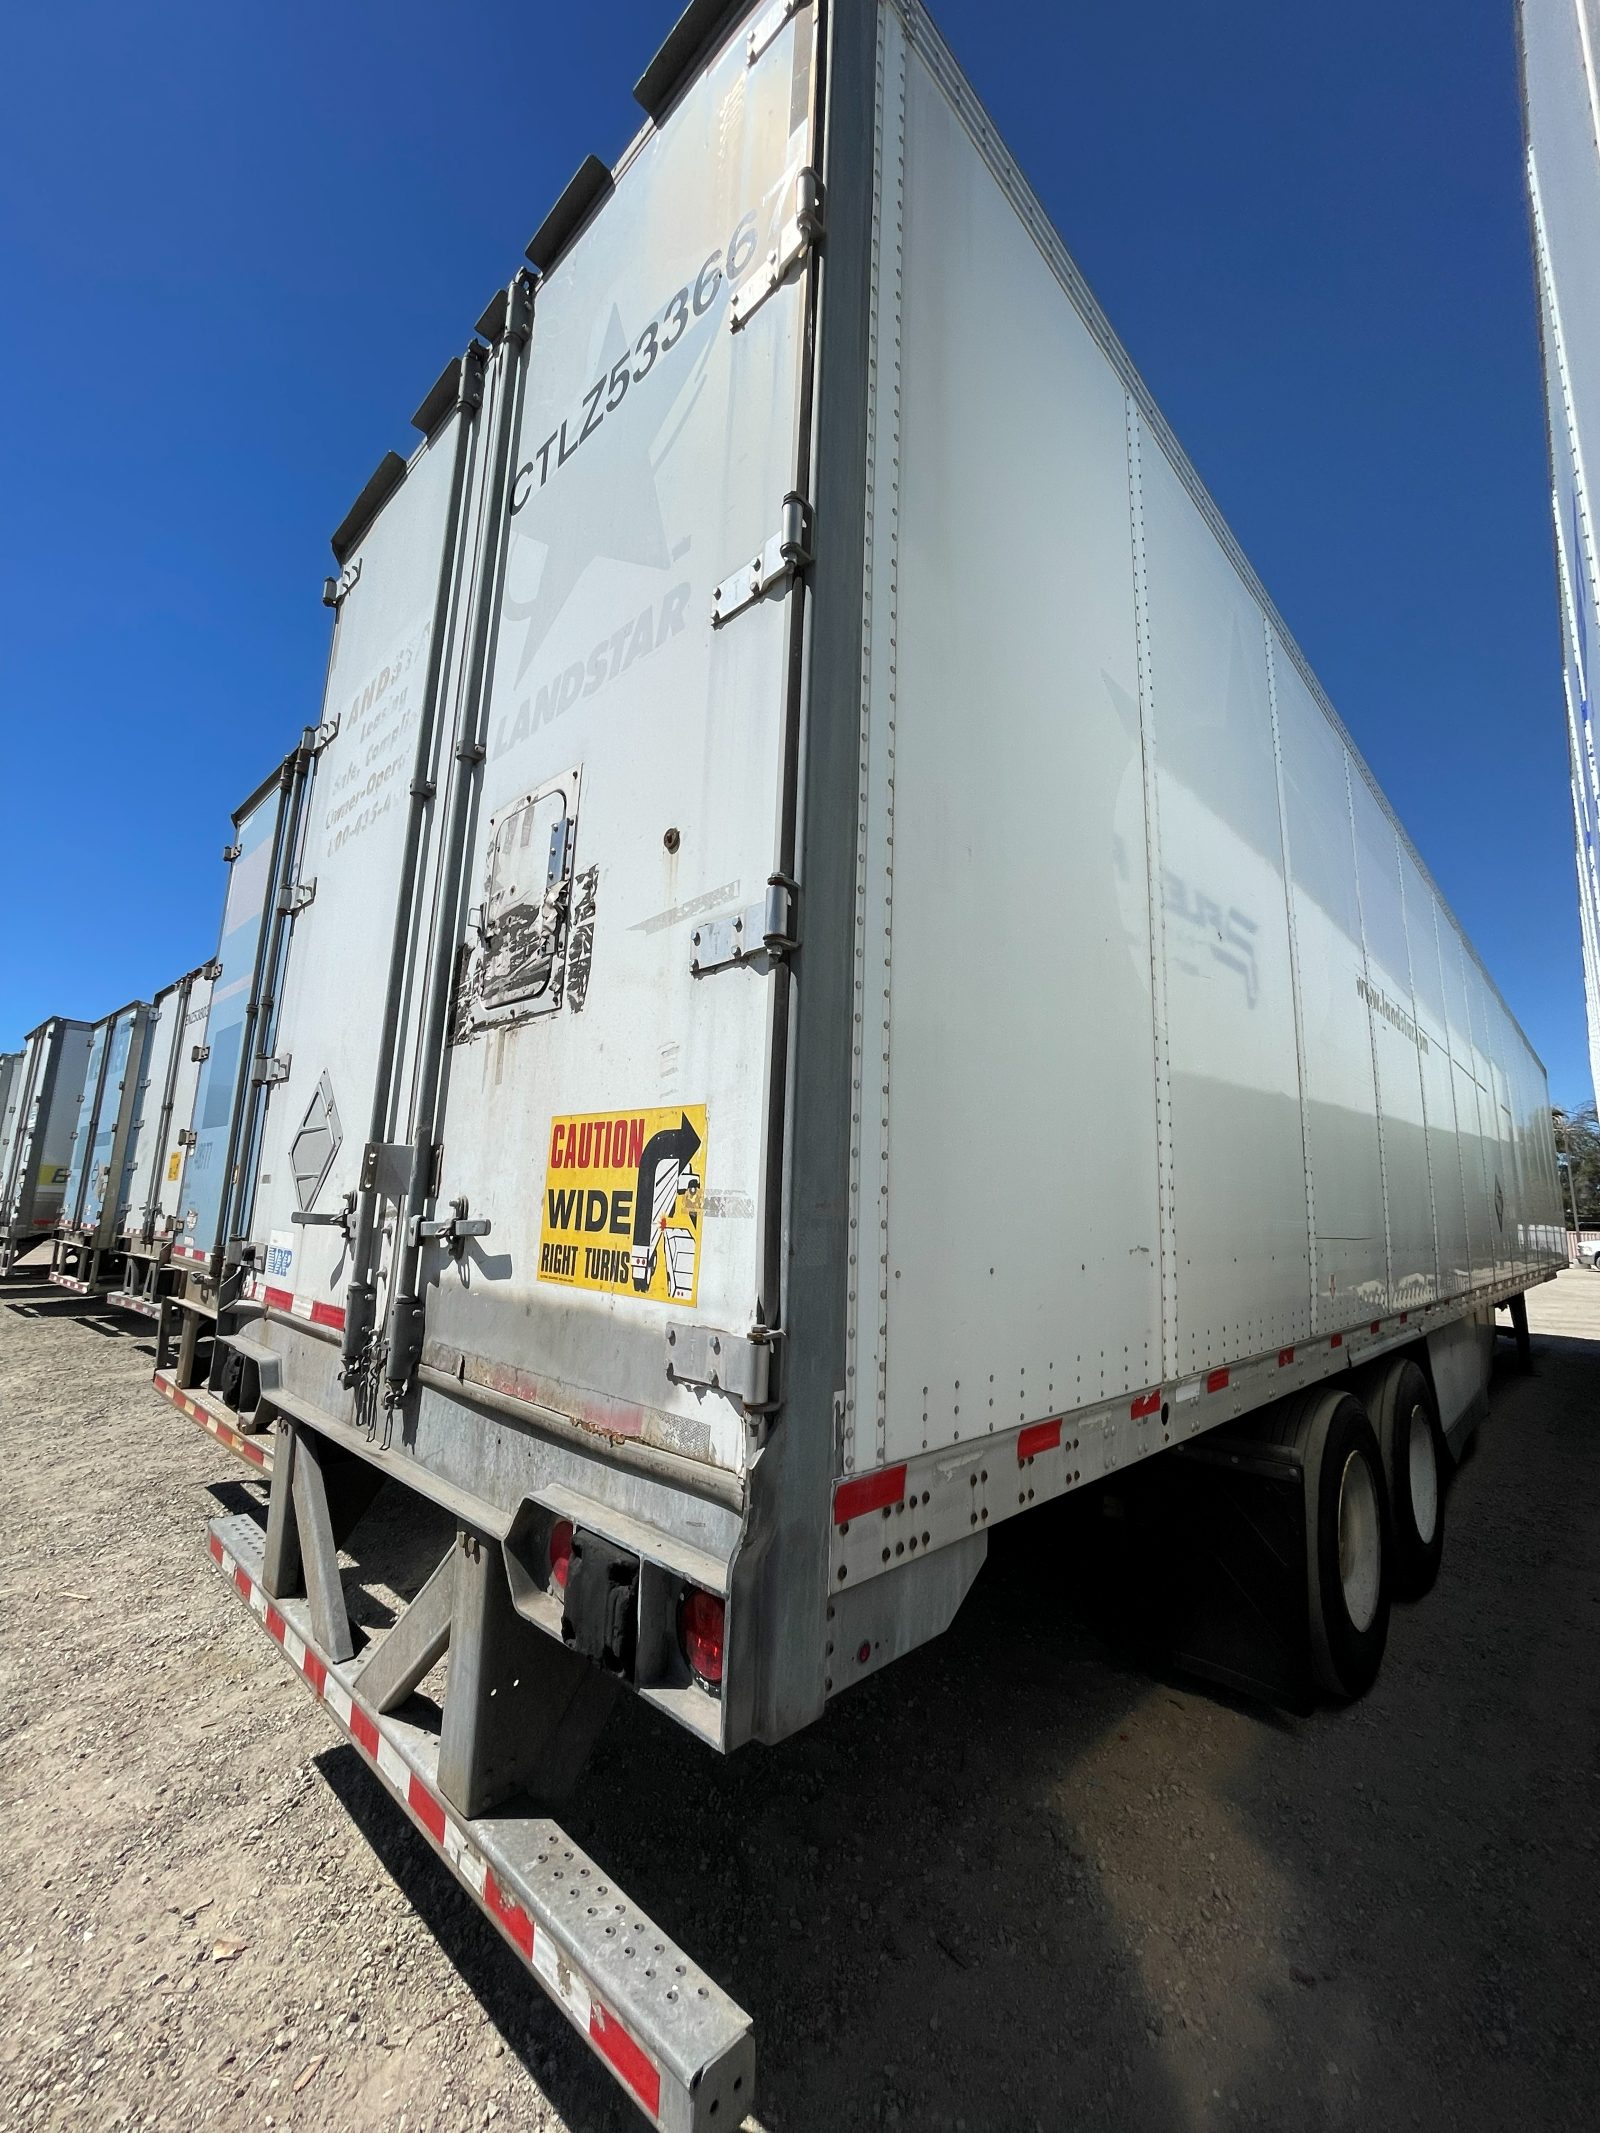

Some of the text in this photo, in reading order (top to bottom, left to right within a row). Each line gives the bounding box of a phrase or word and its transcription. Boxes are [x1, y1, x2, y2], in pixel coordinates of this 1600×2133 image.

[491, 581, 692, 762] LANDSTAR
[1355, 974, 1430, 1057] www.landstar.om
[551, 1118, 646, 1169] CAUTION
[547, 1188, 634, 1236] WIDE
[540, 1242, 631, 1285] RIGHT TURNS
